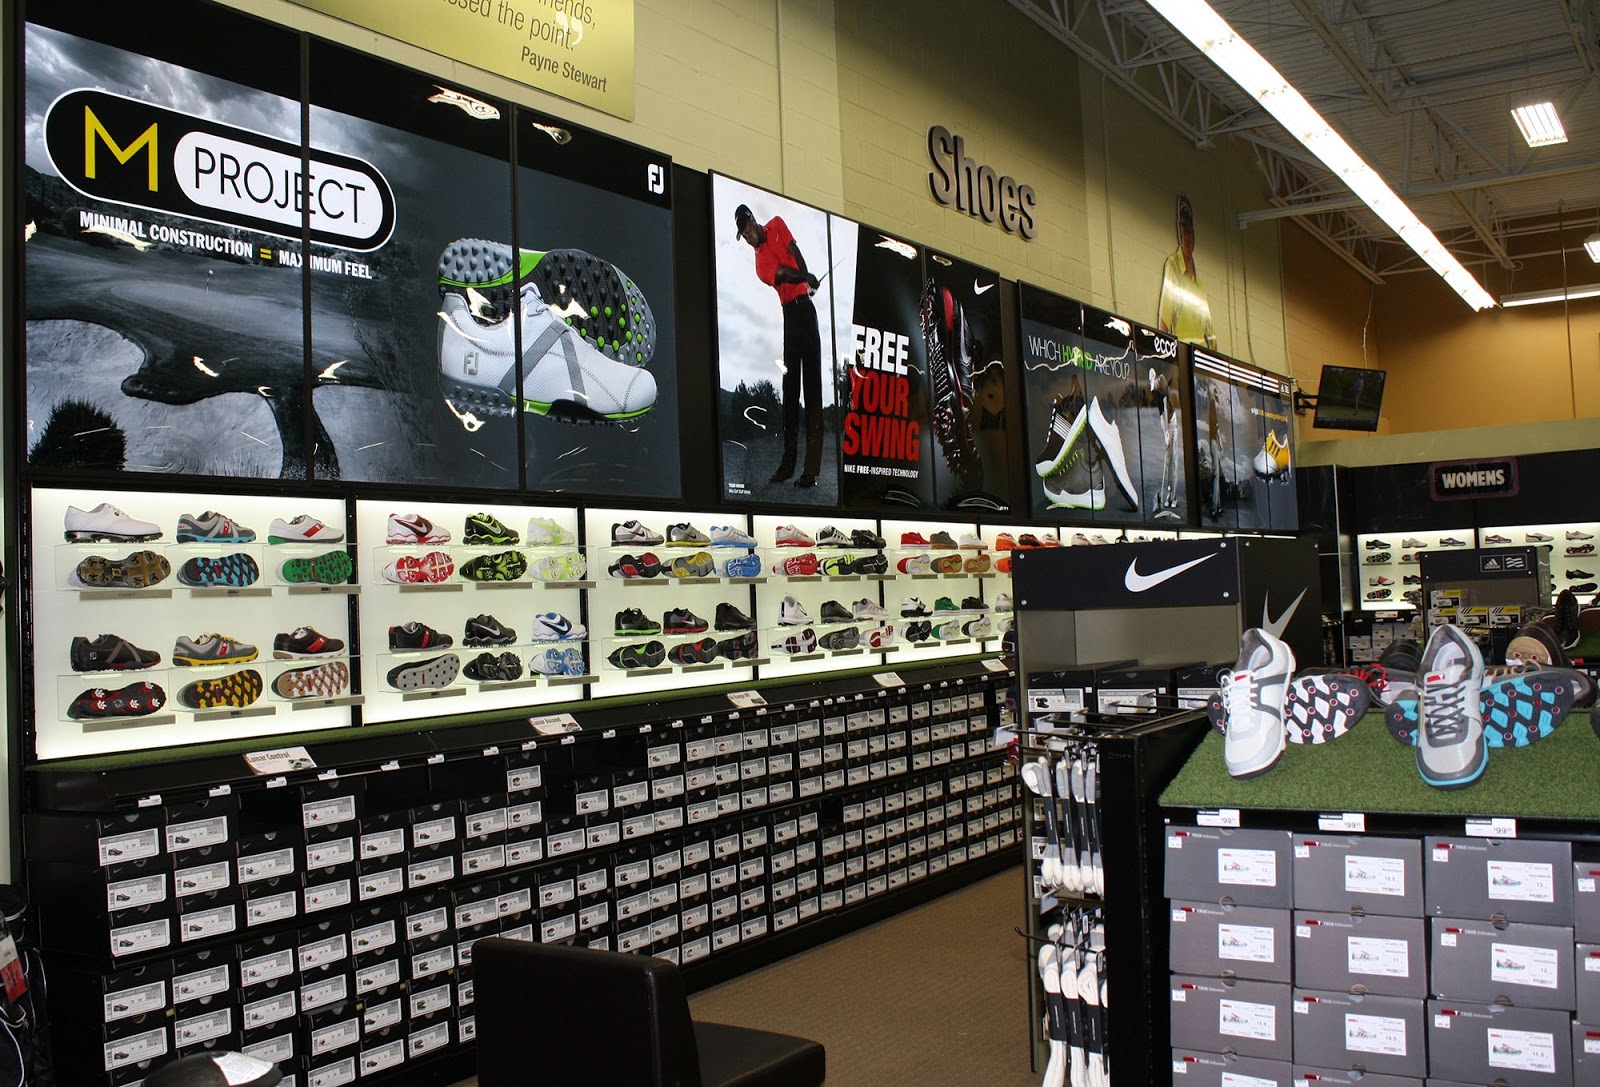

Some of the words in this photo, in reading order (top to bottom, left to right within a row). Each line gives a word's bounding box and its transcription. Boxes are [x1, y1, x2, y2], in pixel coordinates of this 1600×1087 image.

[498, 0, 525, 31] the
[529, 18, 574, 51] point.
[520, 46, 558, 74] Payne
[561, 61, 607, 93] Stewart
[85, 105, 158, 192] M
[195, 146, 365, 223] PROJECT
[927, 125, 1037, 242] Shoes
[80, 210, 147, 239] MINIMAL
[149, 224, 253, 258] CONSTRUCTION
[344, 261, 373, 280] FEEL
[850, 324, 910, 376] FREE
[1028, 335, 1062, 362] WHICH
[1094, 353, 1110, 376] ARE
[1110, 358, 1130, 380] YOU?
[1154, 336, 1177, 358] ecco
[848, 367, 910, 418] YOUR
[843, 412, 921, 462] SWING
[844, 464, 855, 473] NIKE
[892, 468, 919, 479] TECHNOLOGY
[1442, 469, 1505, 489] WOMENS
